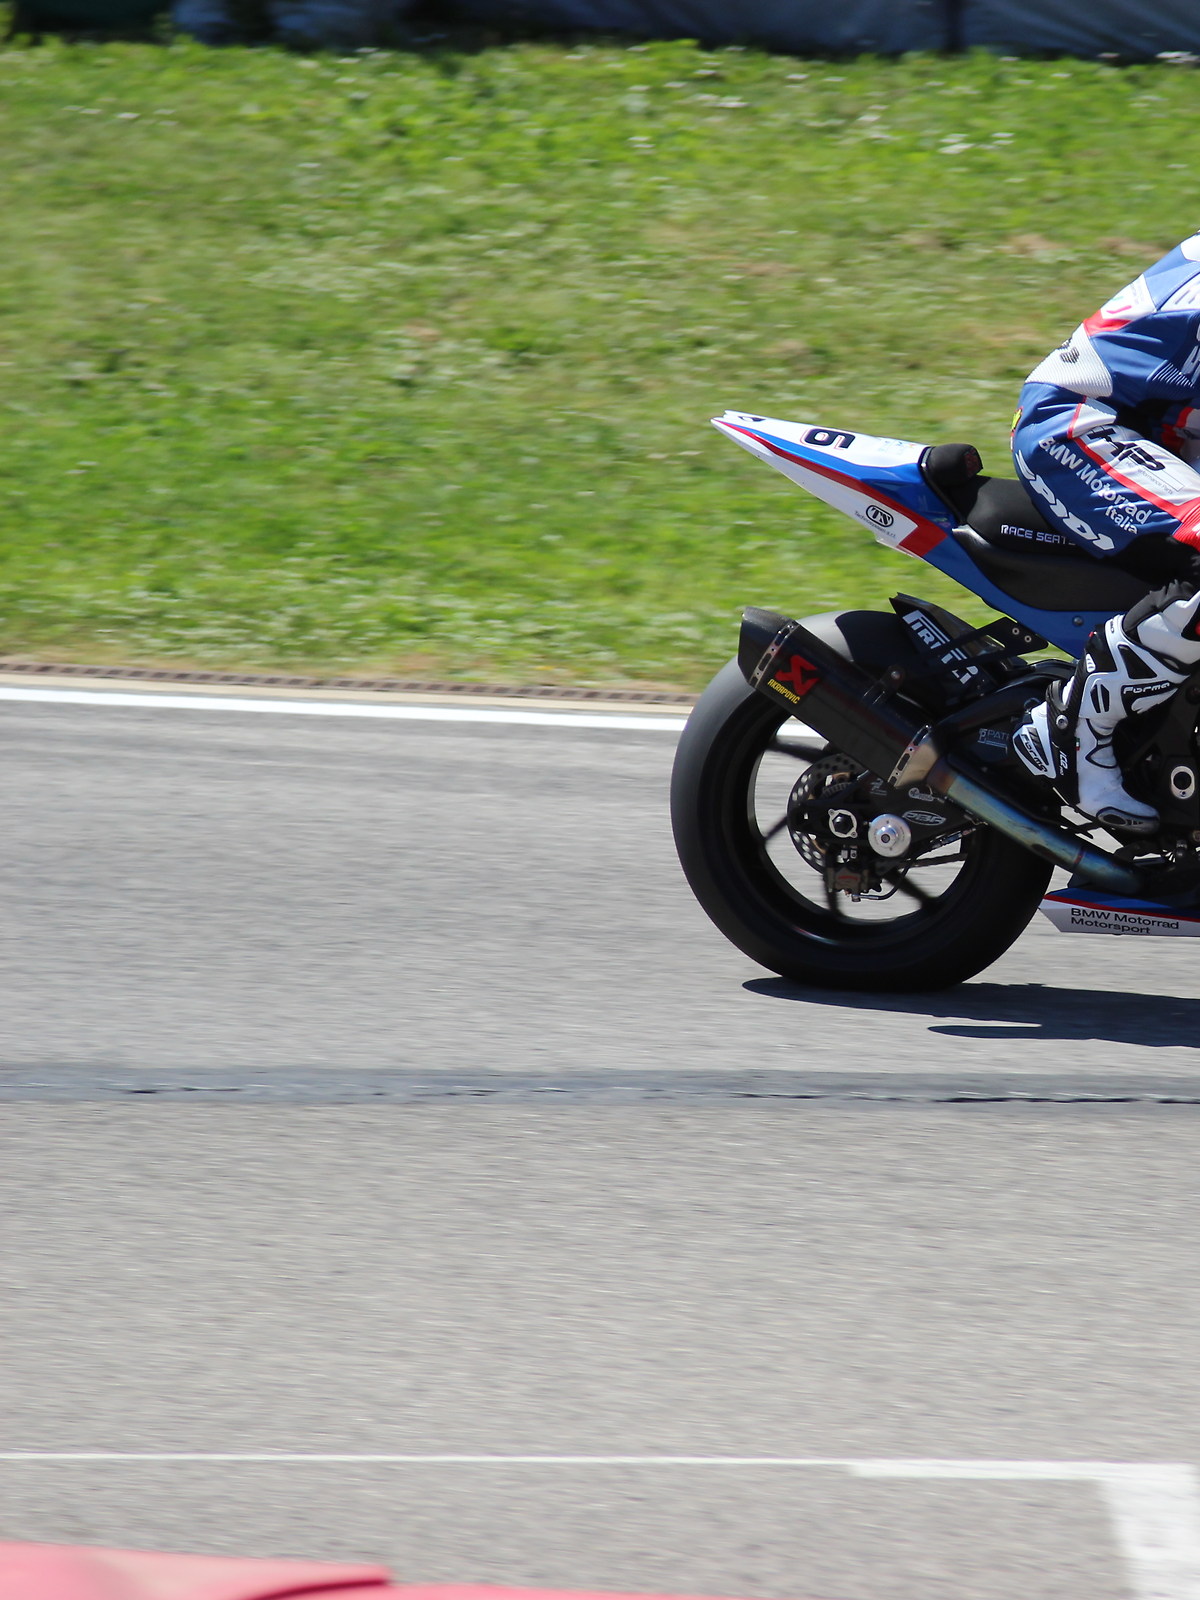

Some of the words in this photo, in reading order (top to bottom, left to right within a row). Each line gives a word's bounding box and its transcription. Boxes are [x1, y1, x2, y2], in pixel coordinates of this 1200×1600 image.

[1039, 436, 1083, 470] BMW
[1076, 463, 1152, 525] Motorrad
[1095, 505, 1138, 534] Italia
[1001, 524, 1033, 539] RACE
[1123, 682, 1170, 695] Forma
[1071, 907, 1110, 919] BMW
[1114, 913, 1180, 930] Motorrad
[1071, 916, 1151, 934] Motorsport
